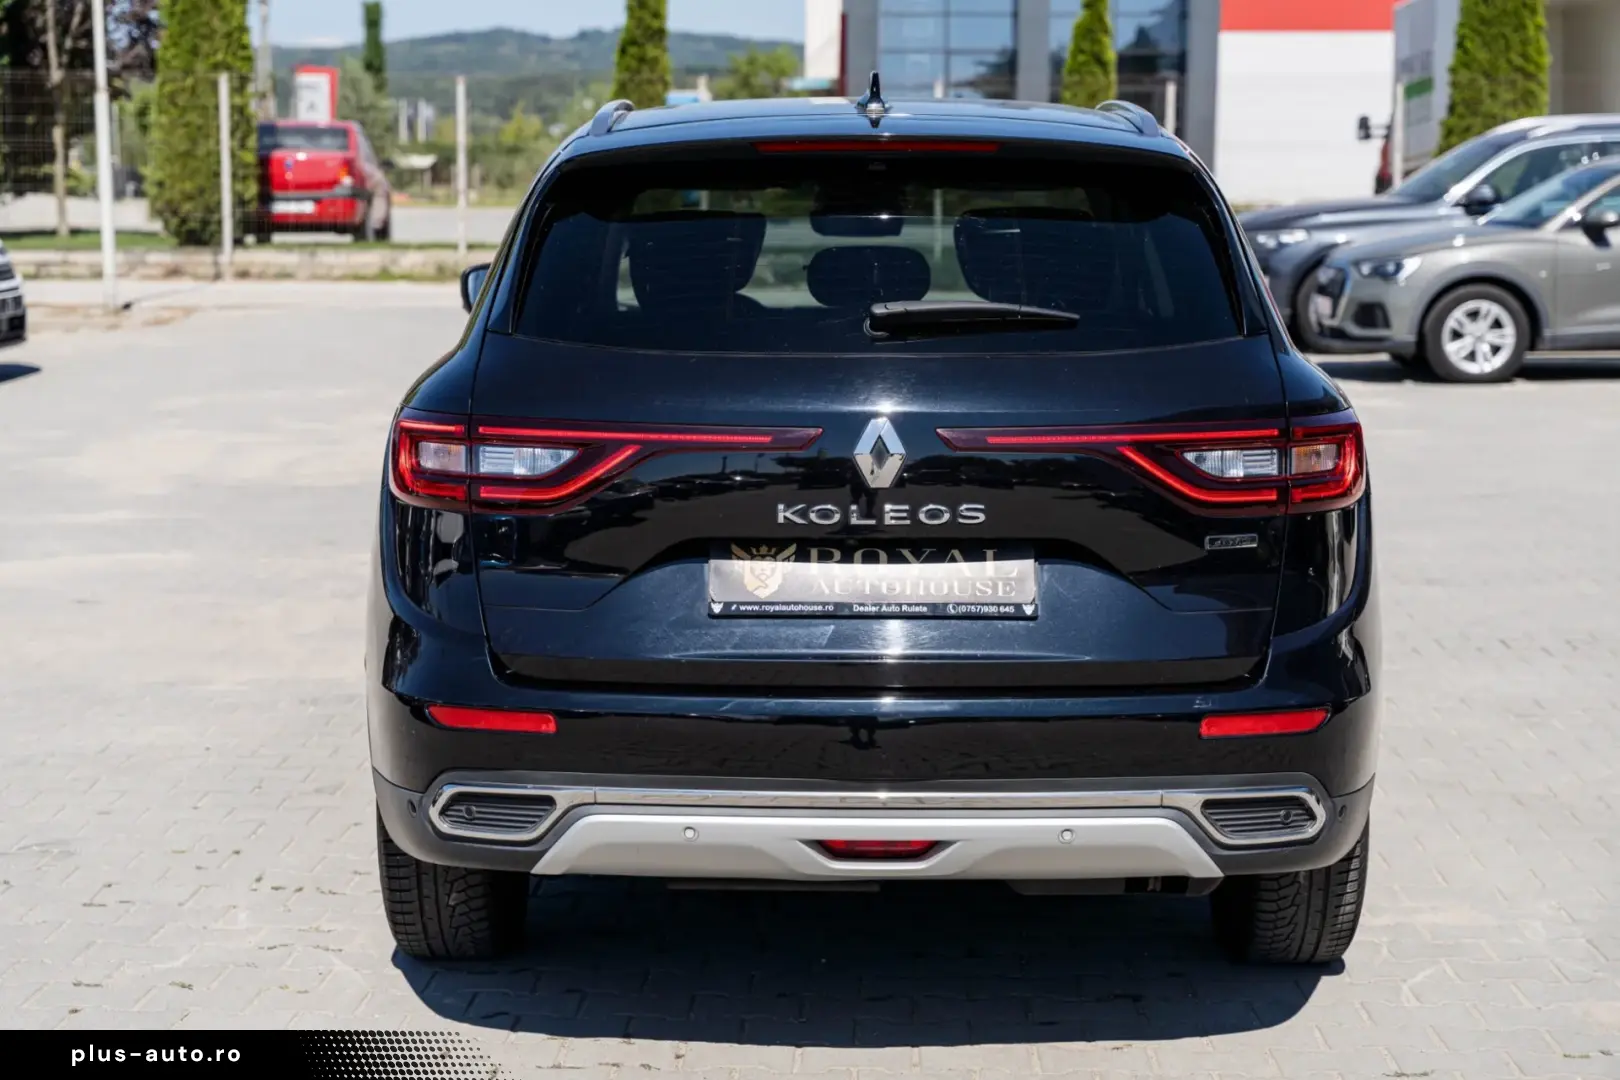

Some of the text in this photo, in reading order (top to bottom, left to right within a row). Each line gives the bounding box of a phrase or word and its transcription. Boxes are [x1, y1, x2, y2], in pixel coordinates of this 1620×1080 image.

[777, 503, 986, 525] KOLEOS
[807, 547, 1018, 578] ROYAL
[811, 577, 1017, 597] AUTOHOUSE
[739, 603, 834, 613] www.royalautohouse.ro
[852, 604, 880, 613] Dealer
[881, 604, 900, 613] Auto
[958, 604, 1015, 614] (0757)930 645
